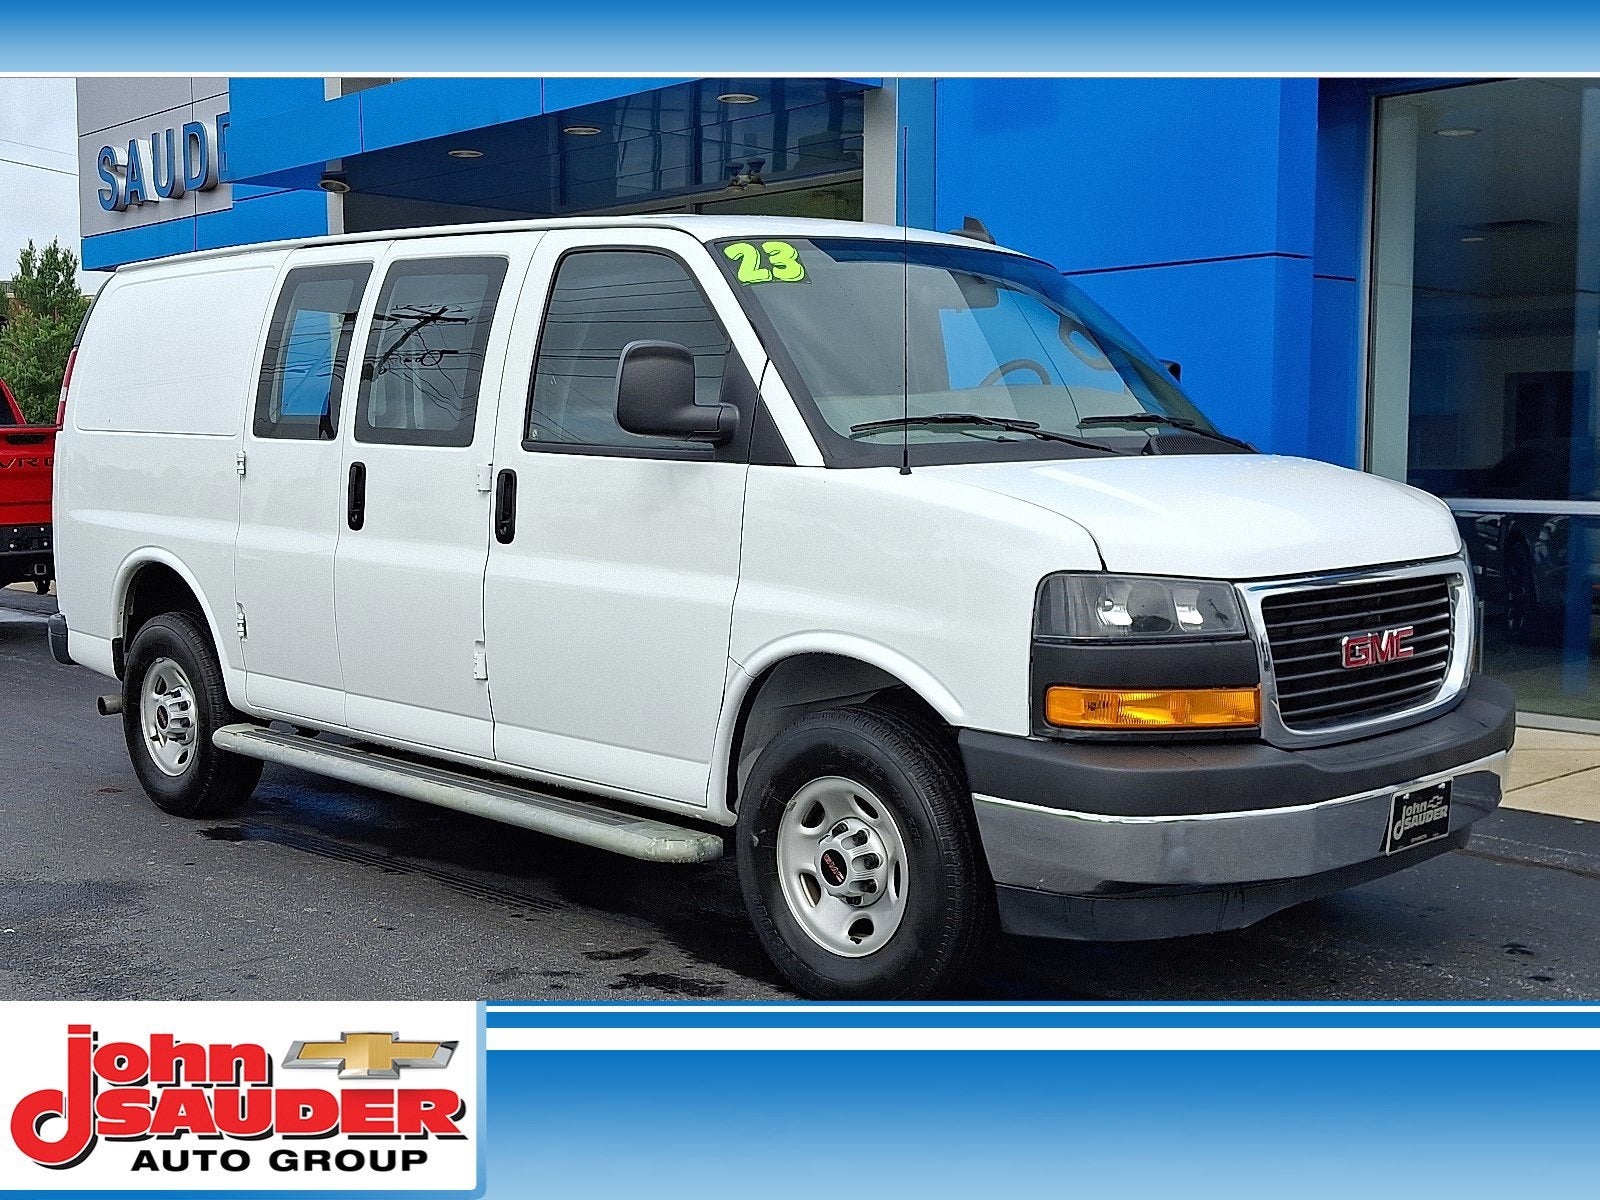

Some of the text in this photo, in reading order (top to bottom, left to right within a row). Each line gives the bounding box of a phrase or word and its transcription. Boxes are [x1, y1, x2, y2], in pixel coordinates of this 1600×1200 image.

[723, 241, 805, 282] 23
[1341, 626, 1414, 668] GMC
[1403, 805, 1449, 830] SAUDER
